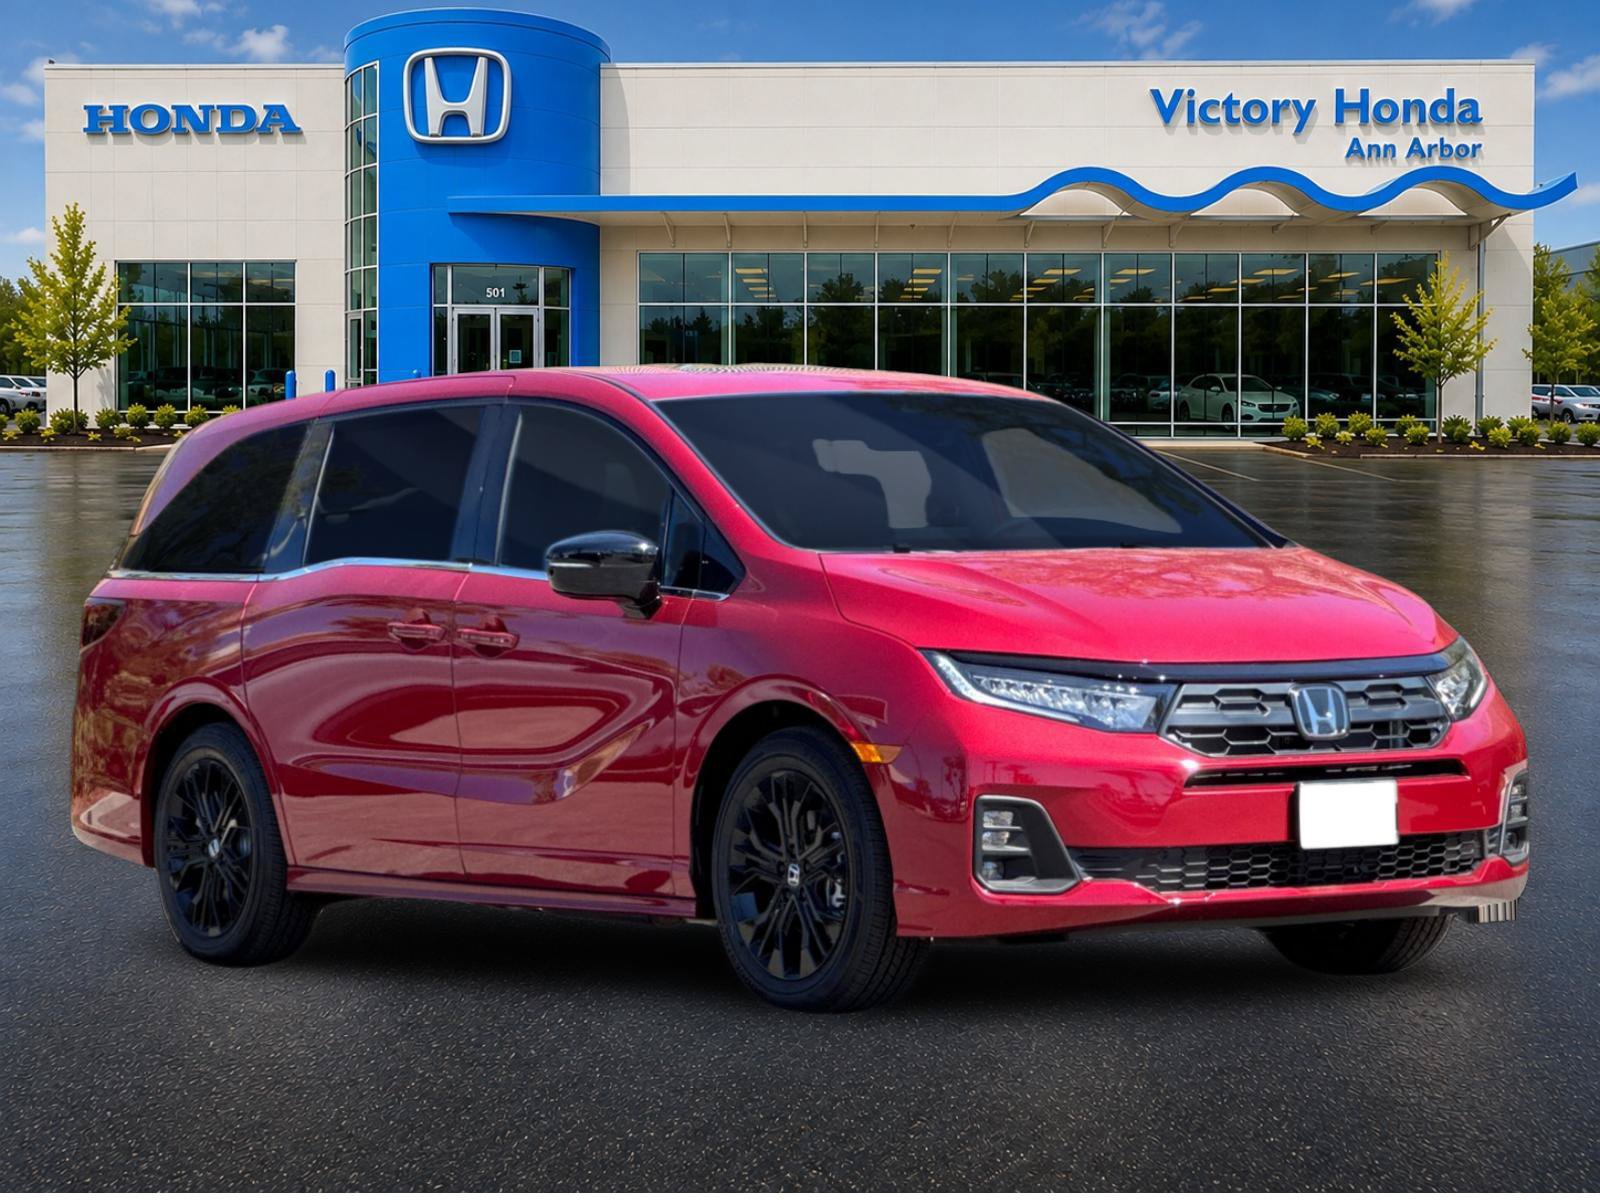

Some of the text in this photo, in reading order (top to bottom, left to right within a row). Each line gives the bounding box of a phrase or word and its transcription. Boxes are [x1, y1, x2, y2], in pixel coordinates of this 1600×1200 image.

[82, 103, 303, 135] HONDA
[1149, 86, 1484, 136] Victory Honda
[1344, 136, 1483, 160] Ann Arbor
[485, 287, 506, 299] 501
